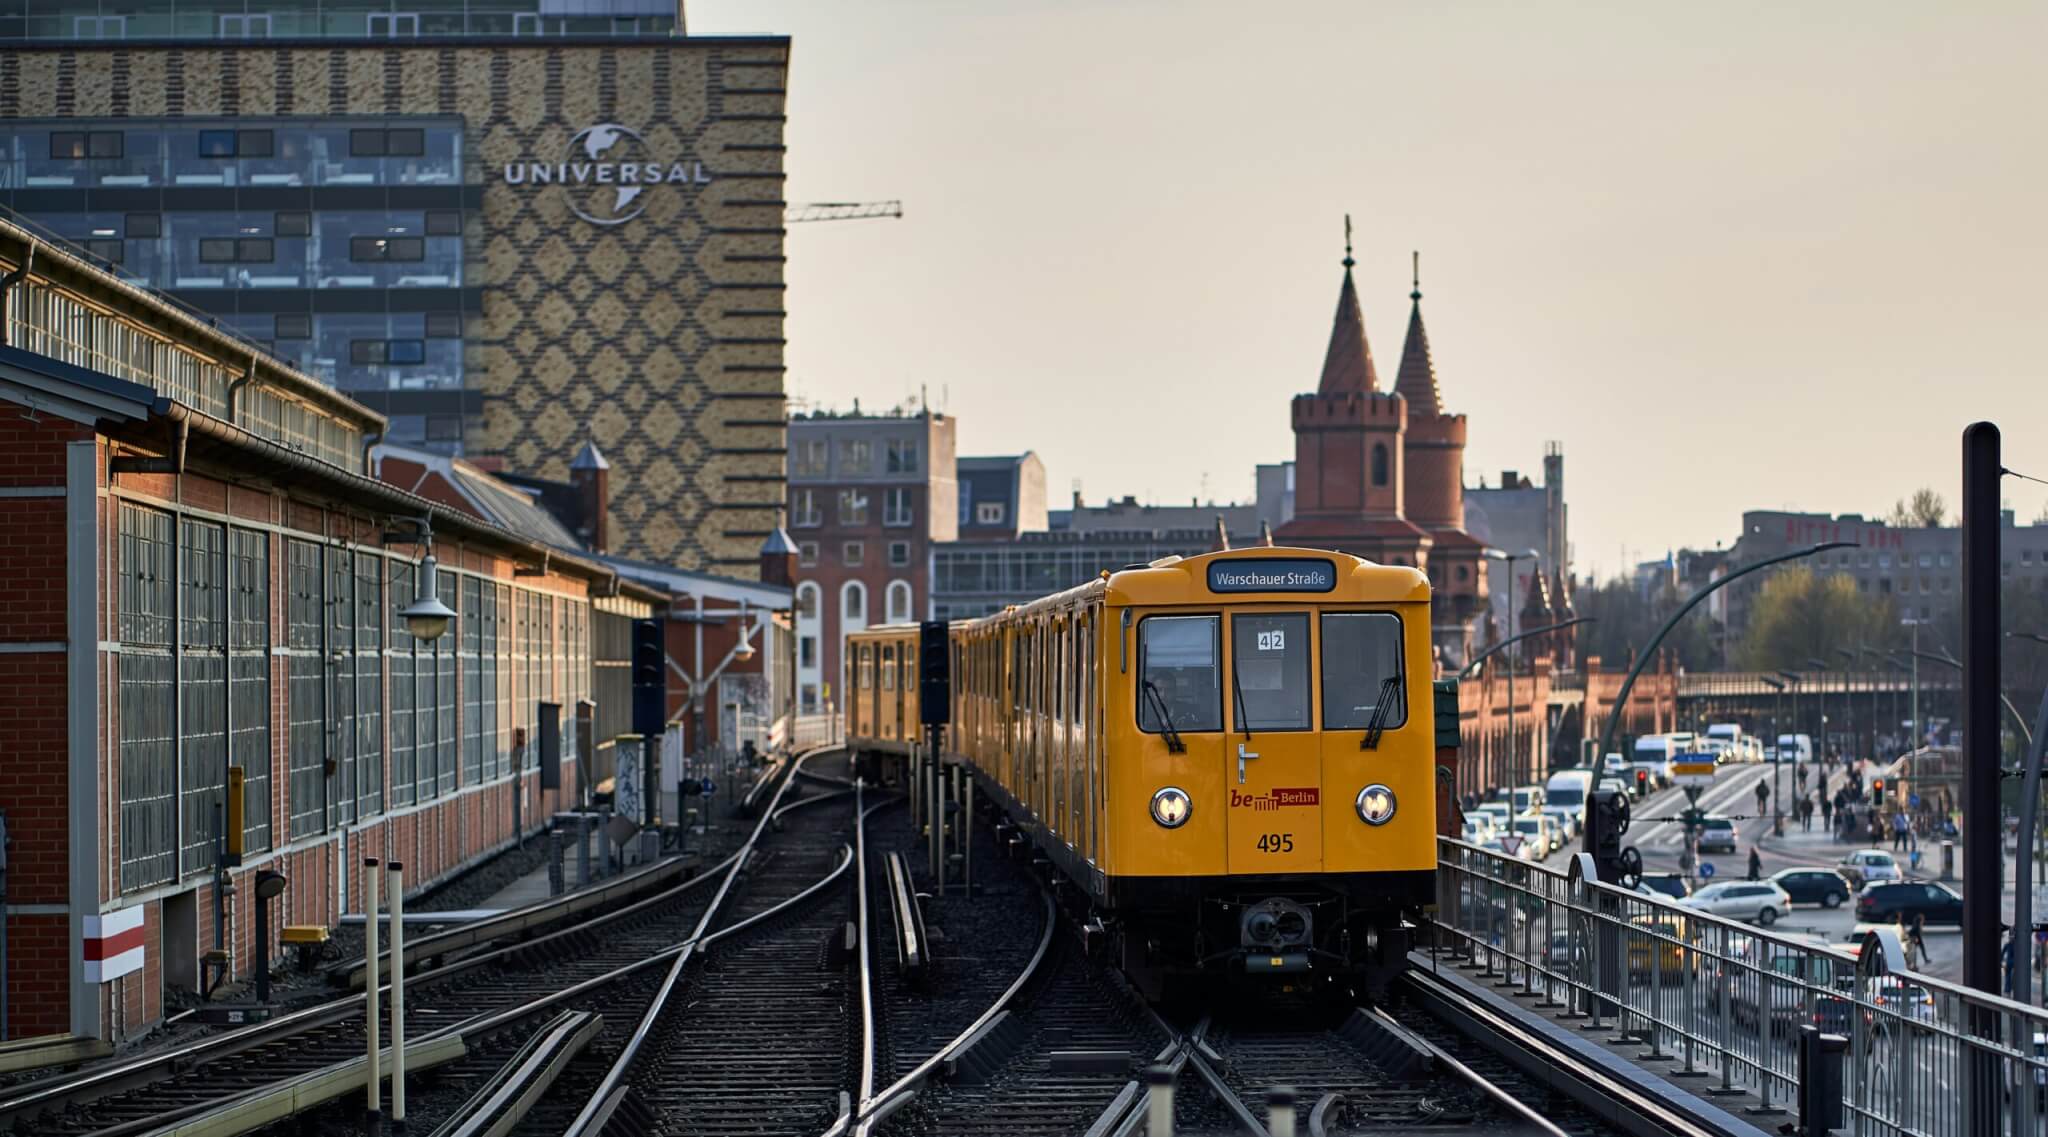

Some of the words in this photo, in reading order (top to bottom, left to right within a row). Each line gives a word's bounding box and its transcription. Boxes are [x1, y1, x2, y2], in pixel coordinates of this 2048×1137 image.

[504, 162, 711, 184] UNIVERSAL
[1216, 571, 1286, 585] Warschauer
[1287, 571, 1326, 585] Straße
[1260, 634, 1283, 648] 42
[1231, 789, 1253, 807] be
[1281, 792, 1315, 803] Berlin
[1257, 833, 1293, 853] 495
